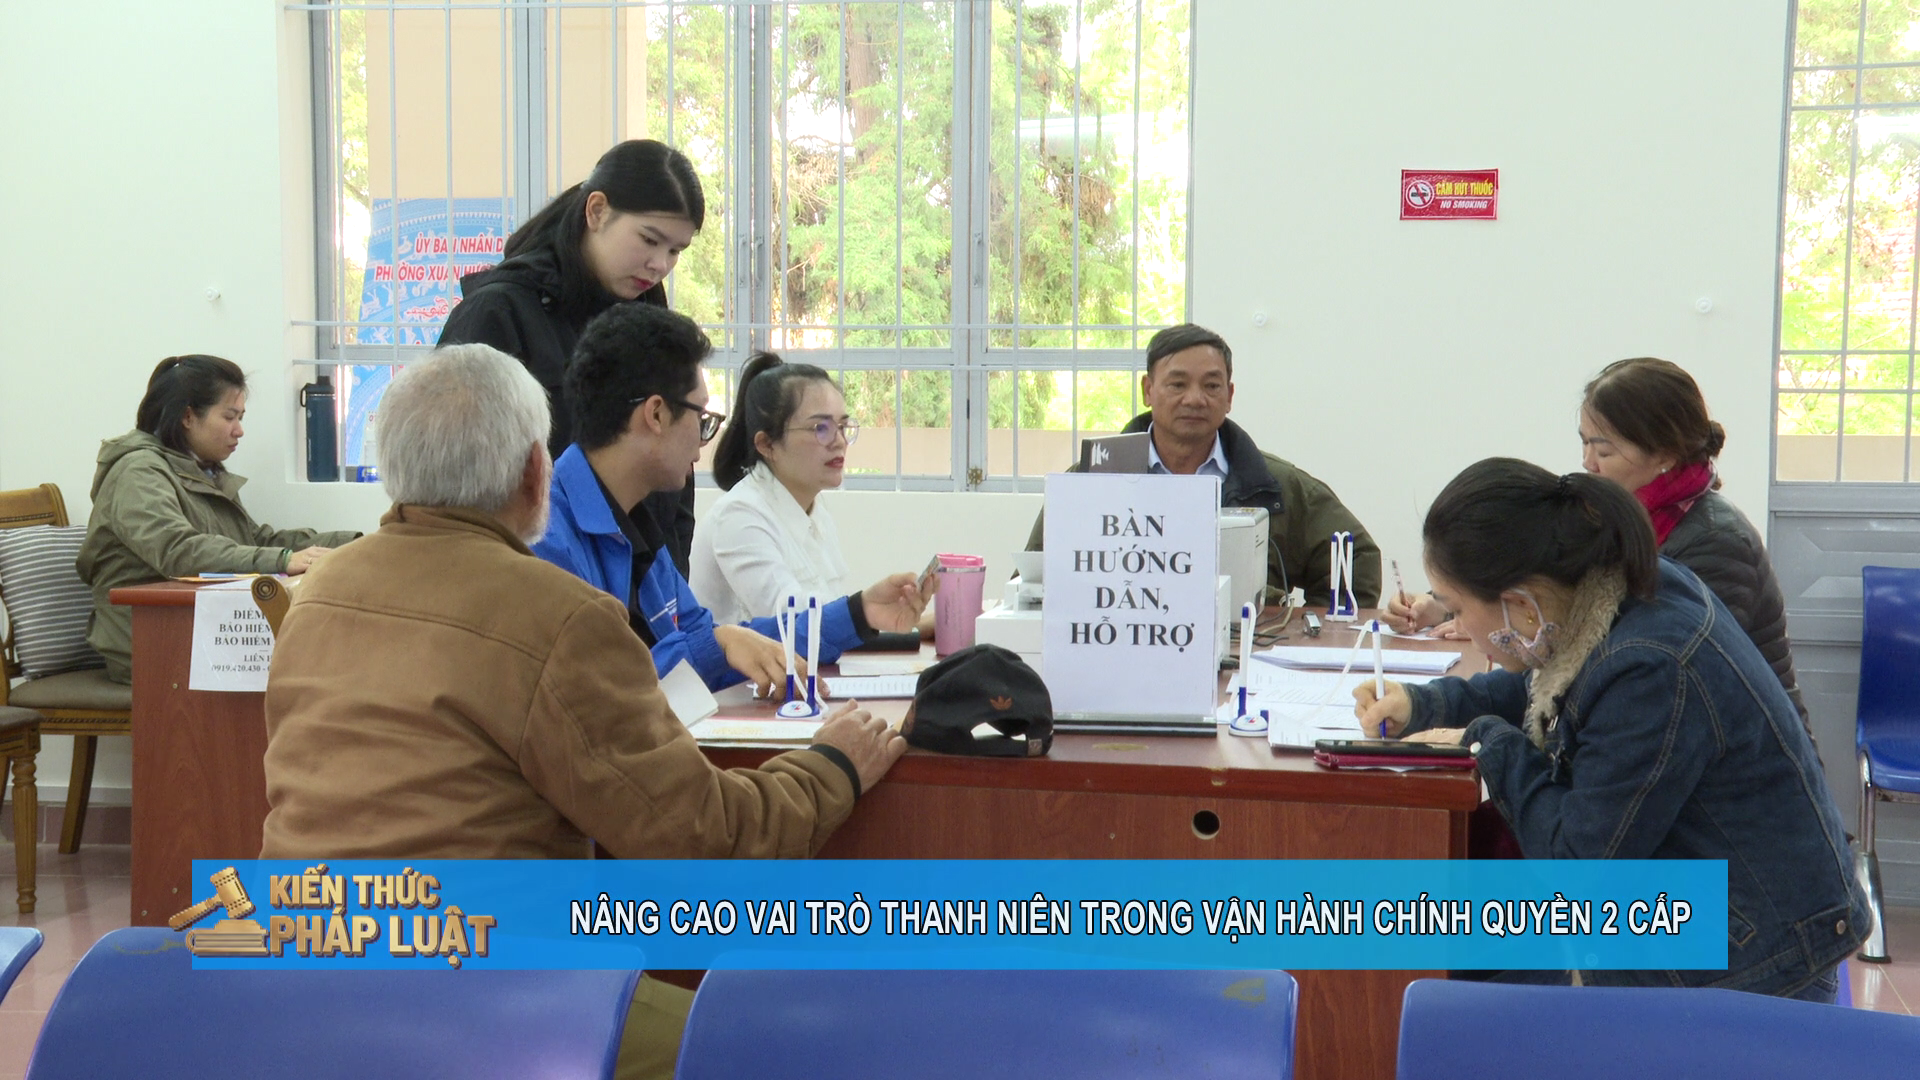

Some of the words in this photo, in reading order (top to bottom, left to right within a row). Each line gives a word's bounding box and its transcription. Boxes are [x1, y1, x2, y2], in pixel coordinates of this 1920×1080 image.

[1470, 178, 1494, 195] THUỐC
[1440, 200, 1452, 209] NO
[1453, 200, 1489, 209] SMOKING
[415, 232, 431, 253] ỦY
[460, 233, 493, 253] NHÂN
[375, 261, 425, 281] PHỜNG
[1101, 508, 1165, 538] BÀN
[1073, 544, 1193, 574] HƯỚNG
[1095, 580, 1170, 615] DẪN,
[1070, 616, 1118, 645] HỖ
[1127, 622, 1195, 653] TRỢ
